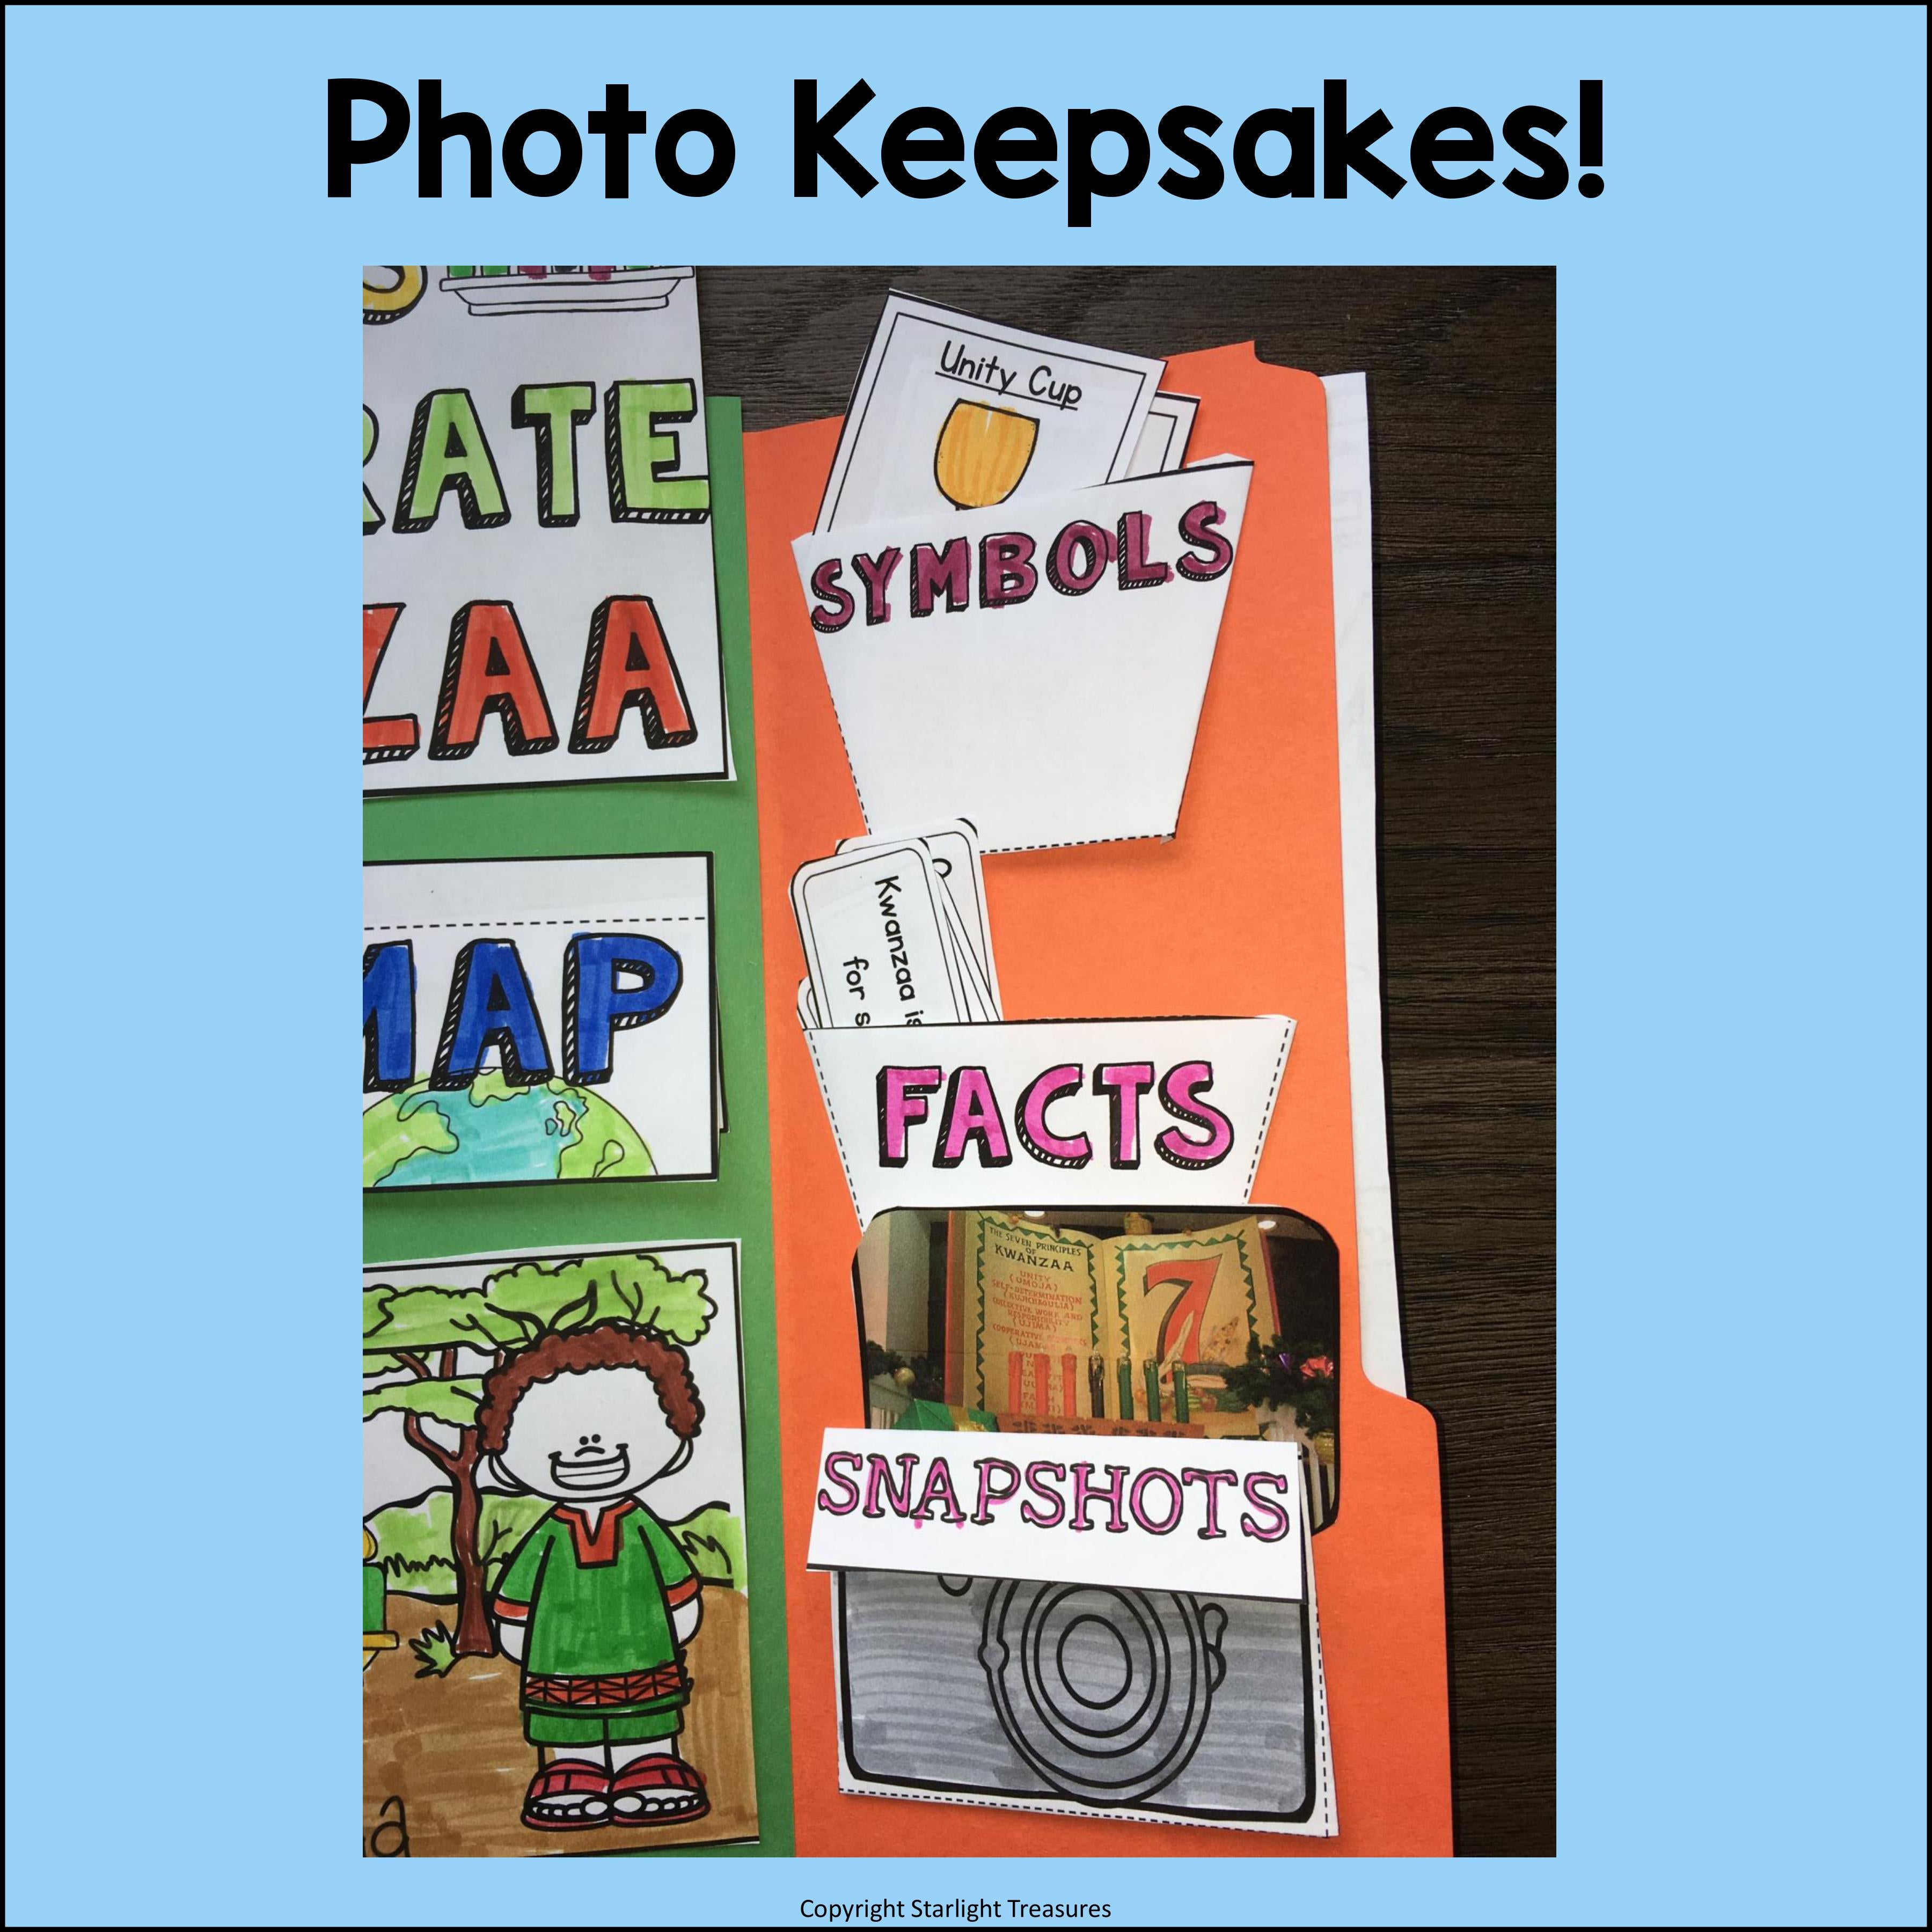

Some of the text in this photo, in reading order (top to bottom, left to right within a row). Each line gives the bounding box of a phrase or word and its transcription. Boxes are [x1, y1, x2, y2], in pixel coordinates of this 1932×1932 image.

[940, 340, 1082, 411] Unity Cup
[363, 378, 711, 535] ATE
[810, 500, 1233, 633] SYMBOLS
[875, 875, 916, 1001] Kwanzaa
[843, 956, 869, 1000] for
[876, 1060, 1234, 1170] FACTS
[990, 1227, 1081, 1256] THE SEVEN PRINCIPLES
[994, 1243, 1074, 1272] KWANZAA
[1020, 1270, 1051, 1282] UNITY
[1026, 1247, 1037, 1256] OF
[992, 1279, 1082, 1306] SELF-DETERMINATION
[1144, 1254, 1221, 1384] 7
[818, 1452, 1289, 1542] SNAPSHOTS
